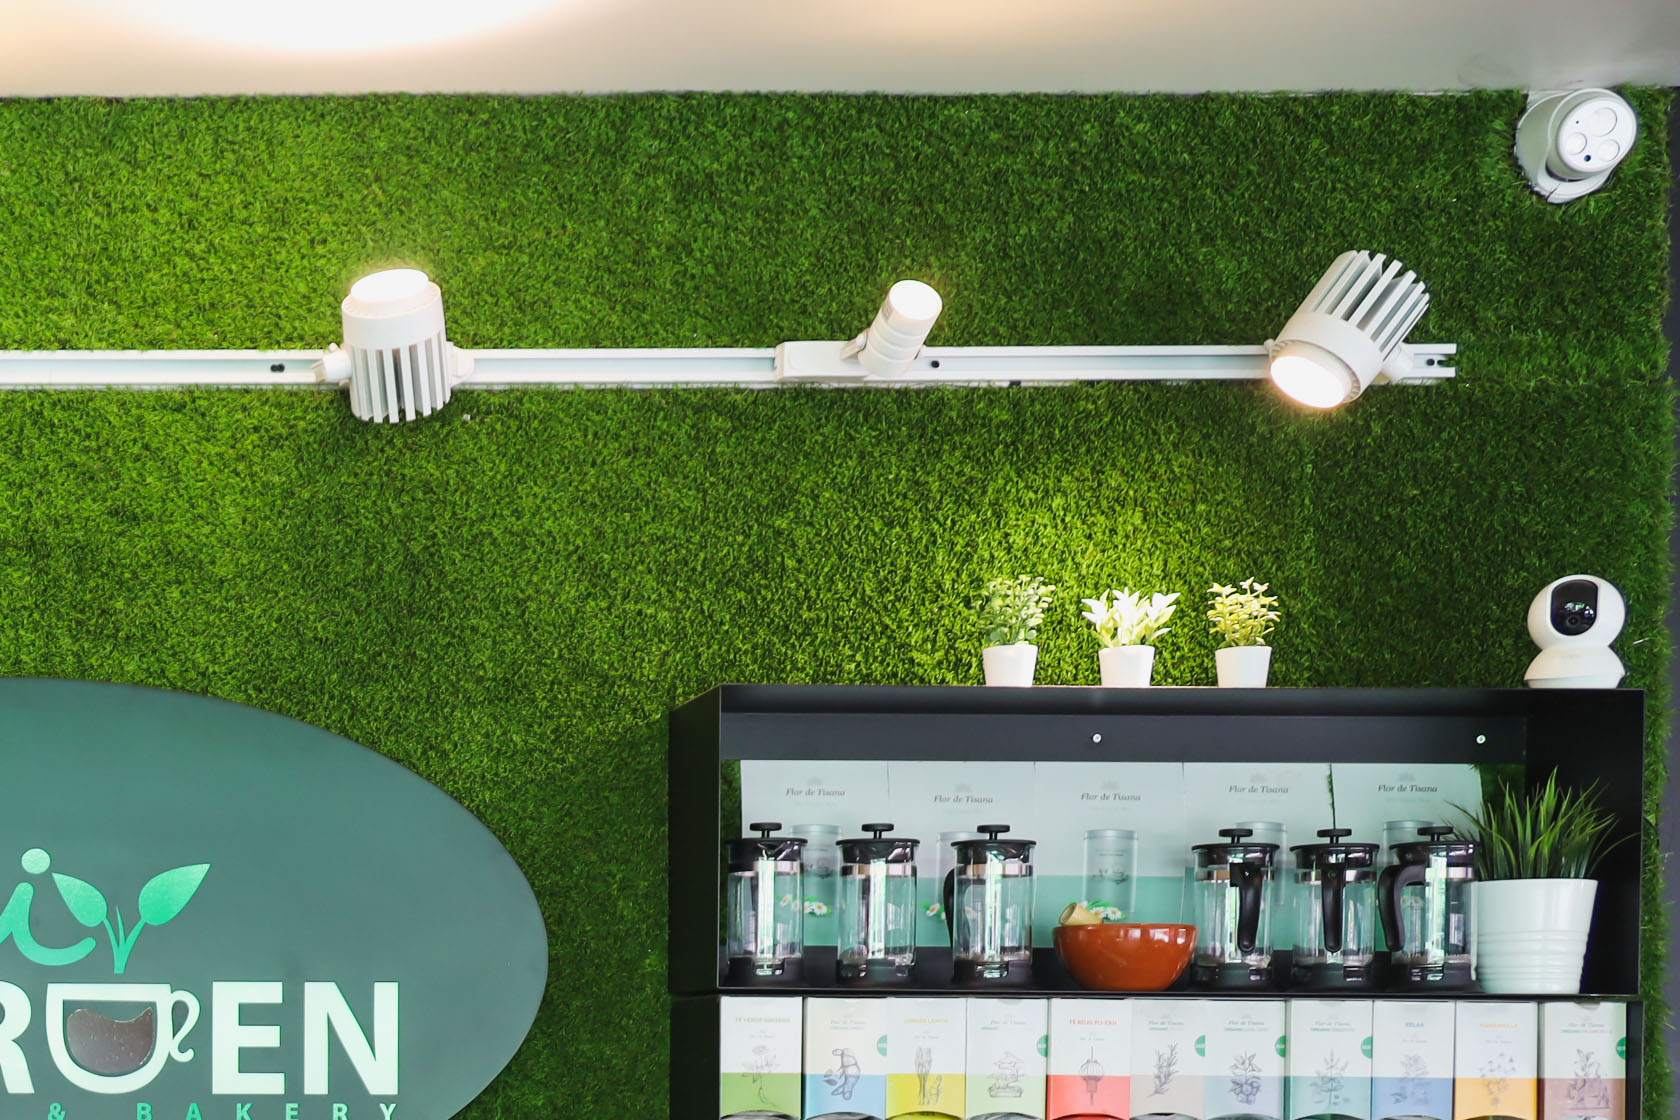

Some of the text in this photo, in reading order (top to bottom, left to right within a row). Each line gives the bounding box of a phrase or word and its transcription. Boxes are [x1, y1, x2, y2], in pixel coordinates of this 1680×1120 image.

[785, 787, 846, 797] Flor de Tisana
[1228, 784, 1289, 793] Flor de Tisana
[1377, 784, 1438, 793] Flor de Tisana
[933, 794, 994, 804] Flor de Tisana
[1080, 792, 1142, 801] Flor de Tisana
